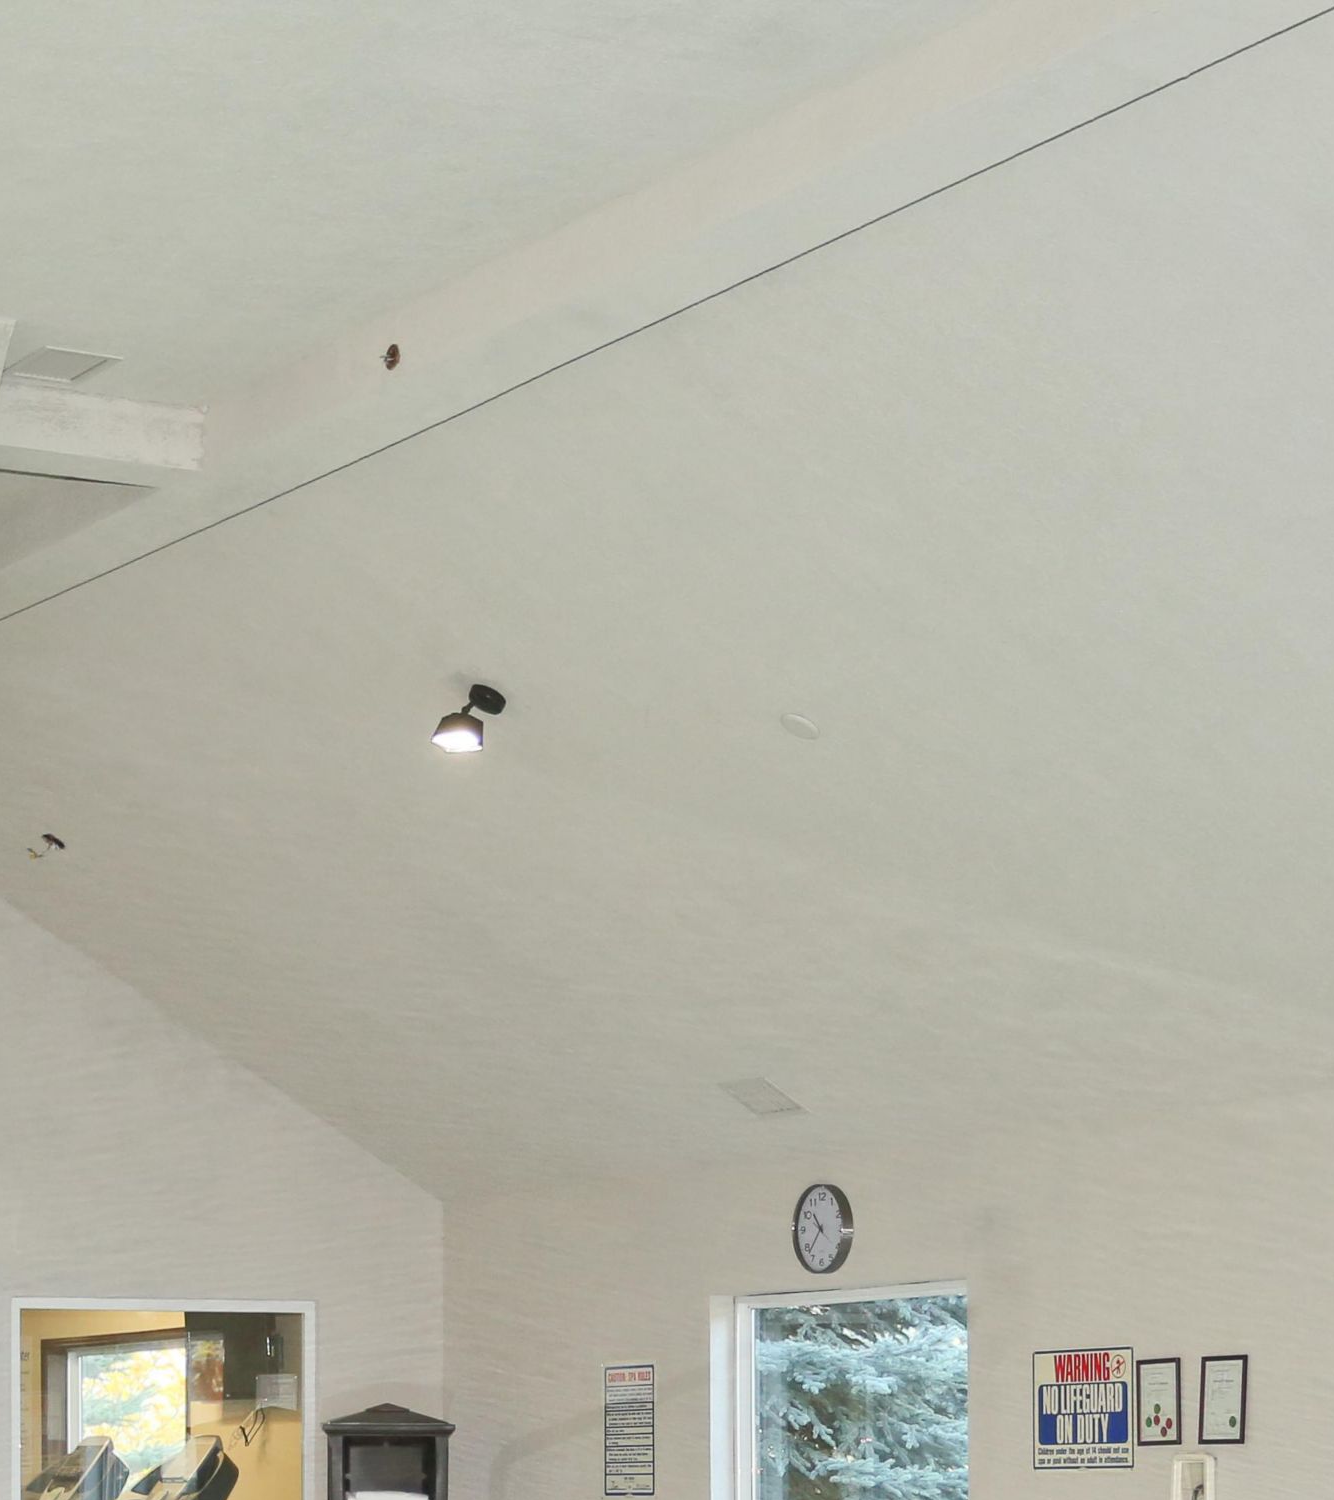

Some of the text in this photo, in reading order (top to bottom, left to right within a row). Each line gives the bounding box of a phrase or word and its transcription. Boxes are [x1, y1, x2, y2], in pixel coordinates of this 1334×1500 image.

[1054, 1352, 1110, 1382] WARNING
[1043, 1383, 1122, 1415] NO LIFEGUARD
[1056, 1414, 1109, 1444] ON DUTY
